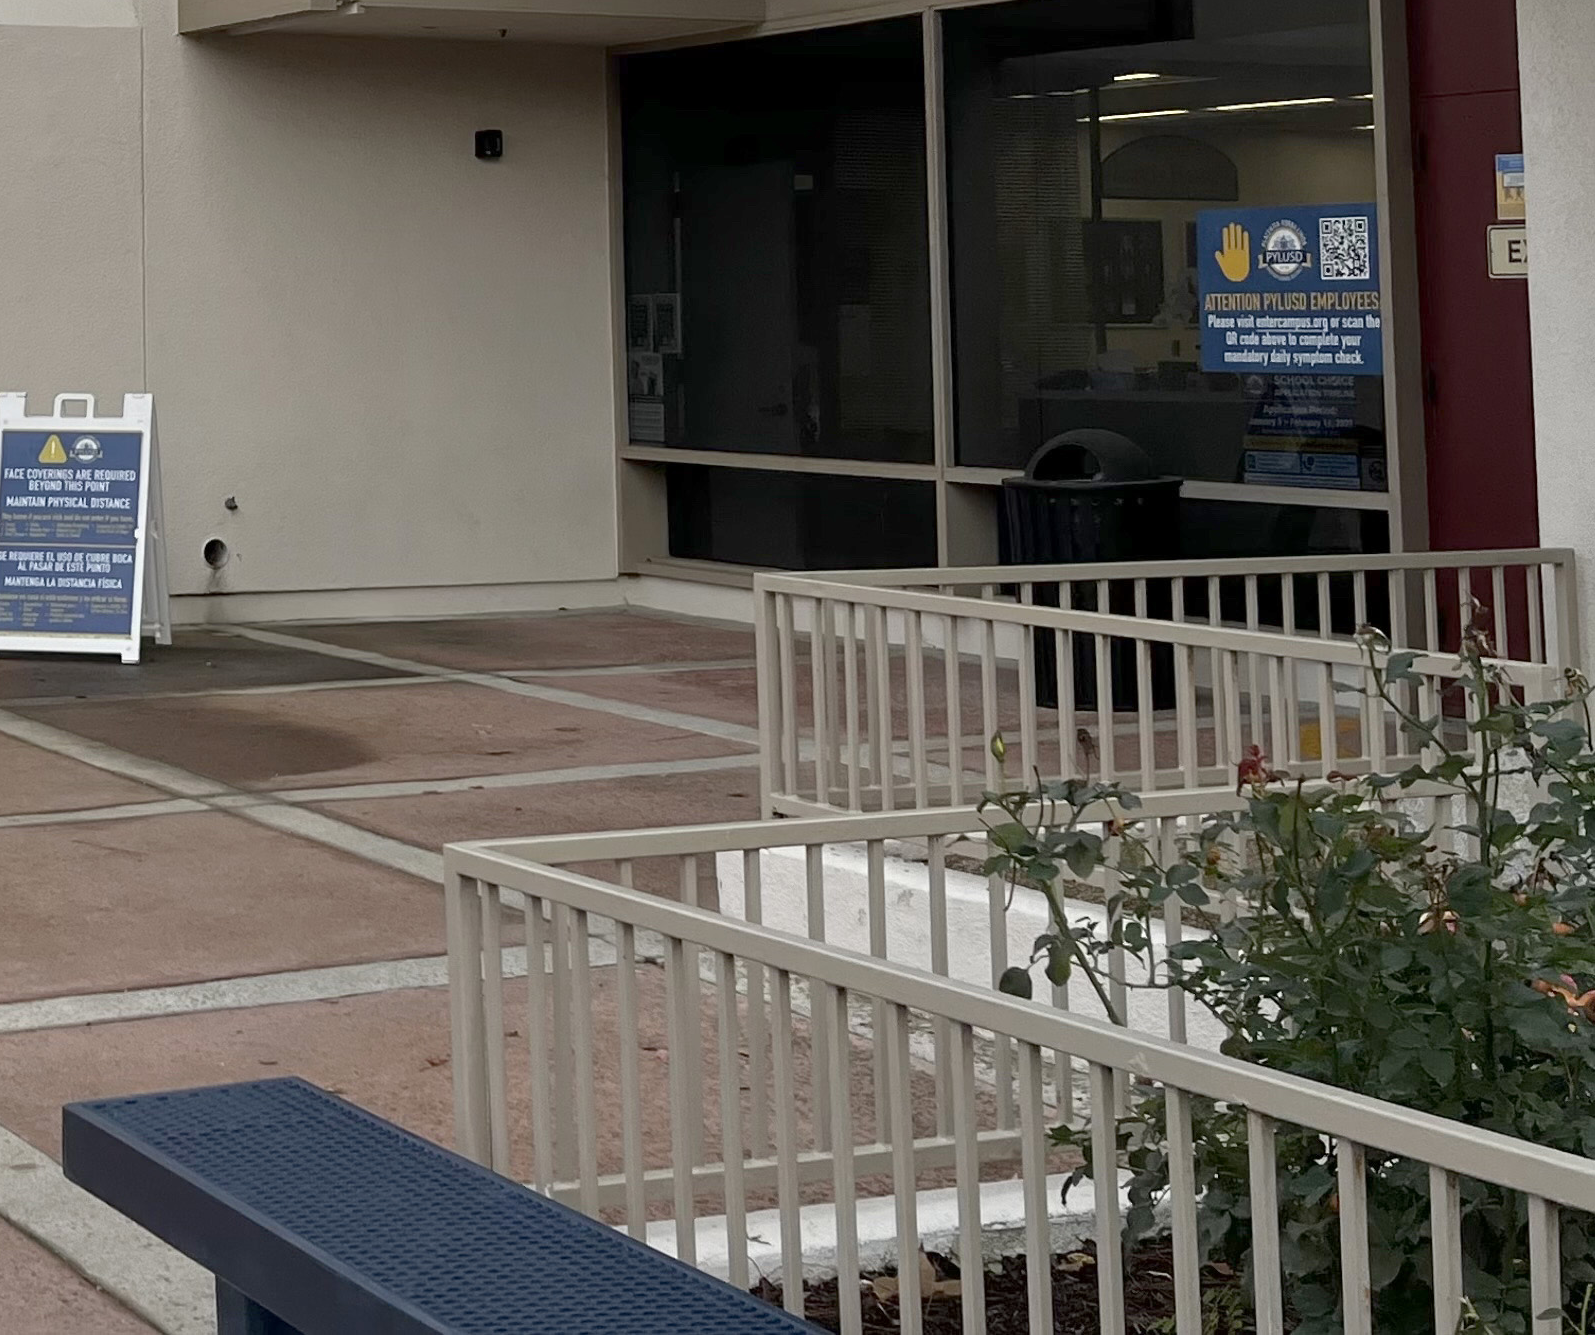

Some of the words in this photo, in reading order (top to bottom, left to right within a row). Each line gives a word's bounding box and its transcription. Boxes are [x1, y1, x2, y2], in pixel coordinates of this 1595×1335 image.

[1265, 250, 1304, 262] PYLUSD
[1204, 292, 1260, 311] ATTENTION
[1264, 292, 1307, 311] PYLUSD
[1207, 314, 1235, 328] Please
[1237, 314, 1254, 328] visit
[1256, 316, 1329, 332] entercampus.org
[1330, 317, 1340, 328] or
[1342, 317, 1364, 328] scan
[1365, 314, 1380, 328] the
[1225, 331, 1238, 346] QR
[1239, 331, 1260, 346] code
[1261, 332, 1286, 346] above
[1288, 332, 1297, 346] to
[1299, 333, 1339, 349] complete
[1340, 334, 1362, 349] your
[1224, 349, 1269, 366] mandatory
[1270, 349, 1291, 366] daily
[1293, 351, 1333, 366] symptom
[1334, 350, 1364, 364] check.
[1273, 374, 1314, 385] SCHOOL
[4, 468, 25, 479] FACE
[27, 468, 73, 480] COVERINGS
[75, 469, 92, 480] ARE
[94, 469, 136, 481] REQUIRED
[28, 480, 62, 491] BEYOND
[64, 480, 83, 491] THIS
[85, 481, 110, 492] POINT
[6, 496, 45, 507] MAINTAIN
[47, 497, 88, 508] PHYSICAL
[90, 497, 131, 509] DISTANCE
[28, 562, 53, 572] PASAR
[4, 575, 45, 587] MANTENGA
[46, 577, 56, 588] LA
[57, 577, 96, 588] DISTANCIA
